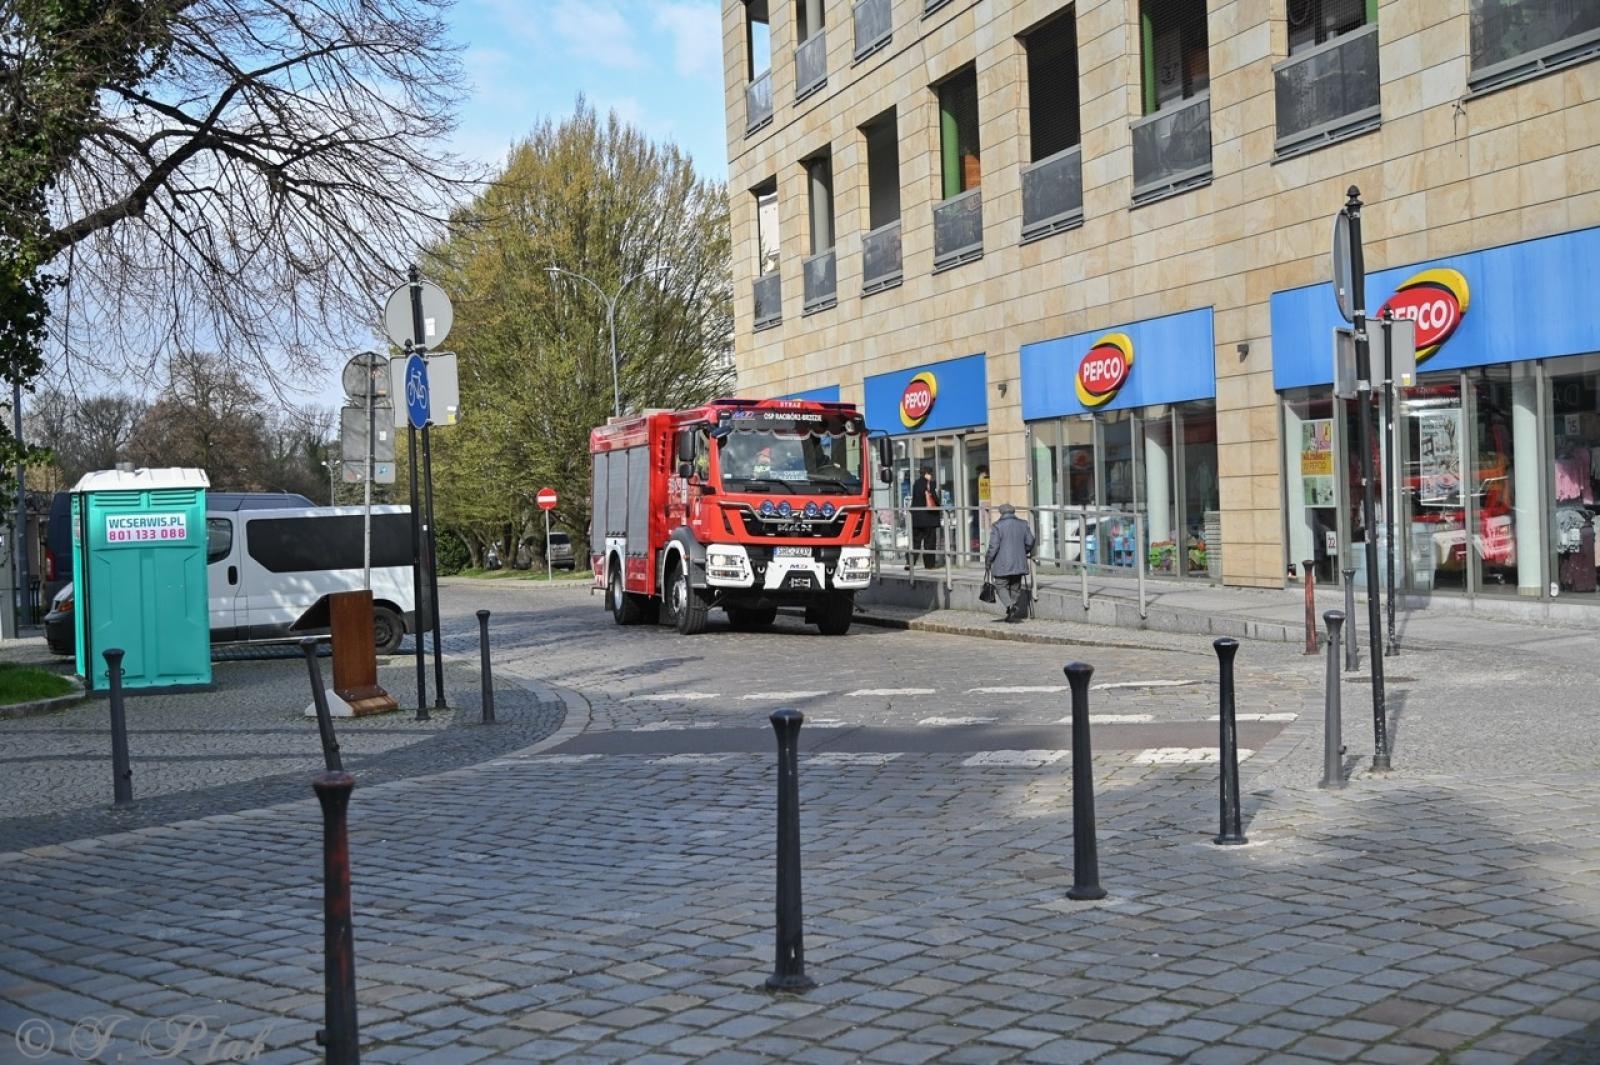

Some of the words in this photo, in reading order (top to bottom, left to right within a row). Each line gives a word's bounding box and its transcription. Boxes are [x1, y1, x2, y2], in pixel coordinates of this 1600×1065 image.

[1388, 299, 1448, 331] EPCO
[1083, 356, 1121, 384] PEPCO
[904, 390, 928, 410] PEPCO
[108, 516, 185, 529] WCSERWIS.PL
[109, 530, 131, 541] 801
[136, 529, 156, 540] 133
[161, 528, 185, 539] 088
